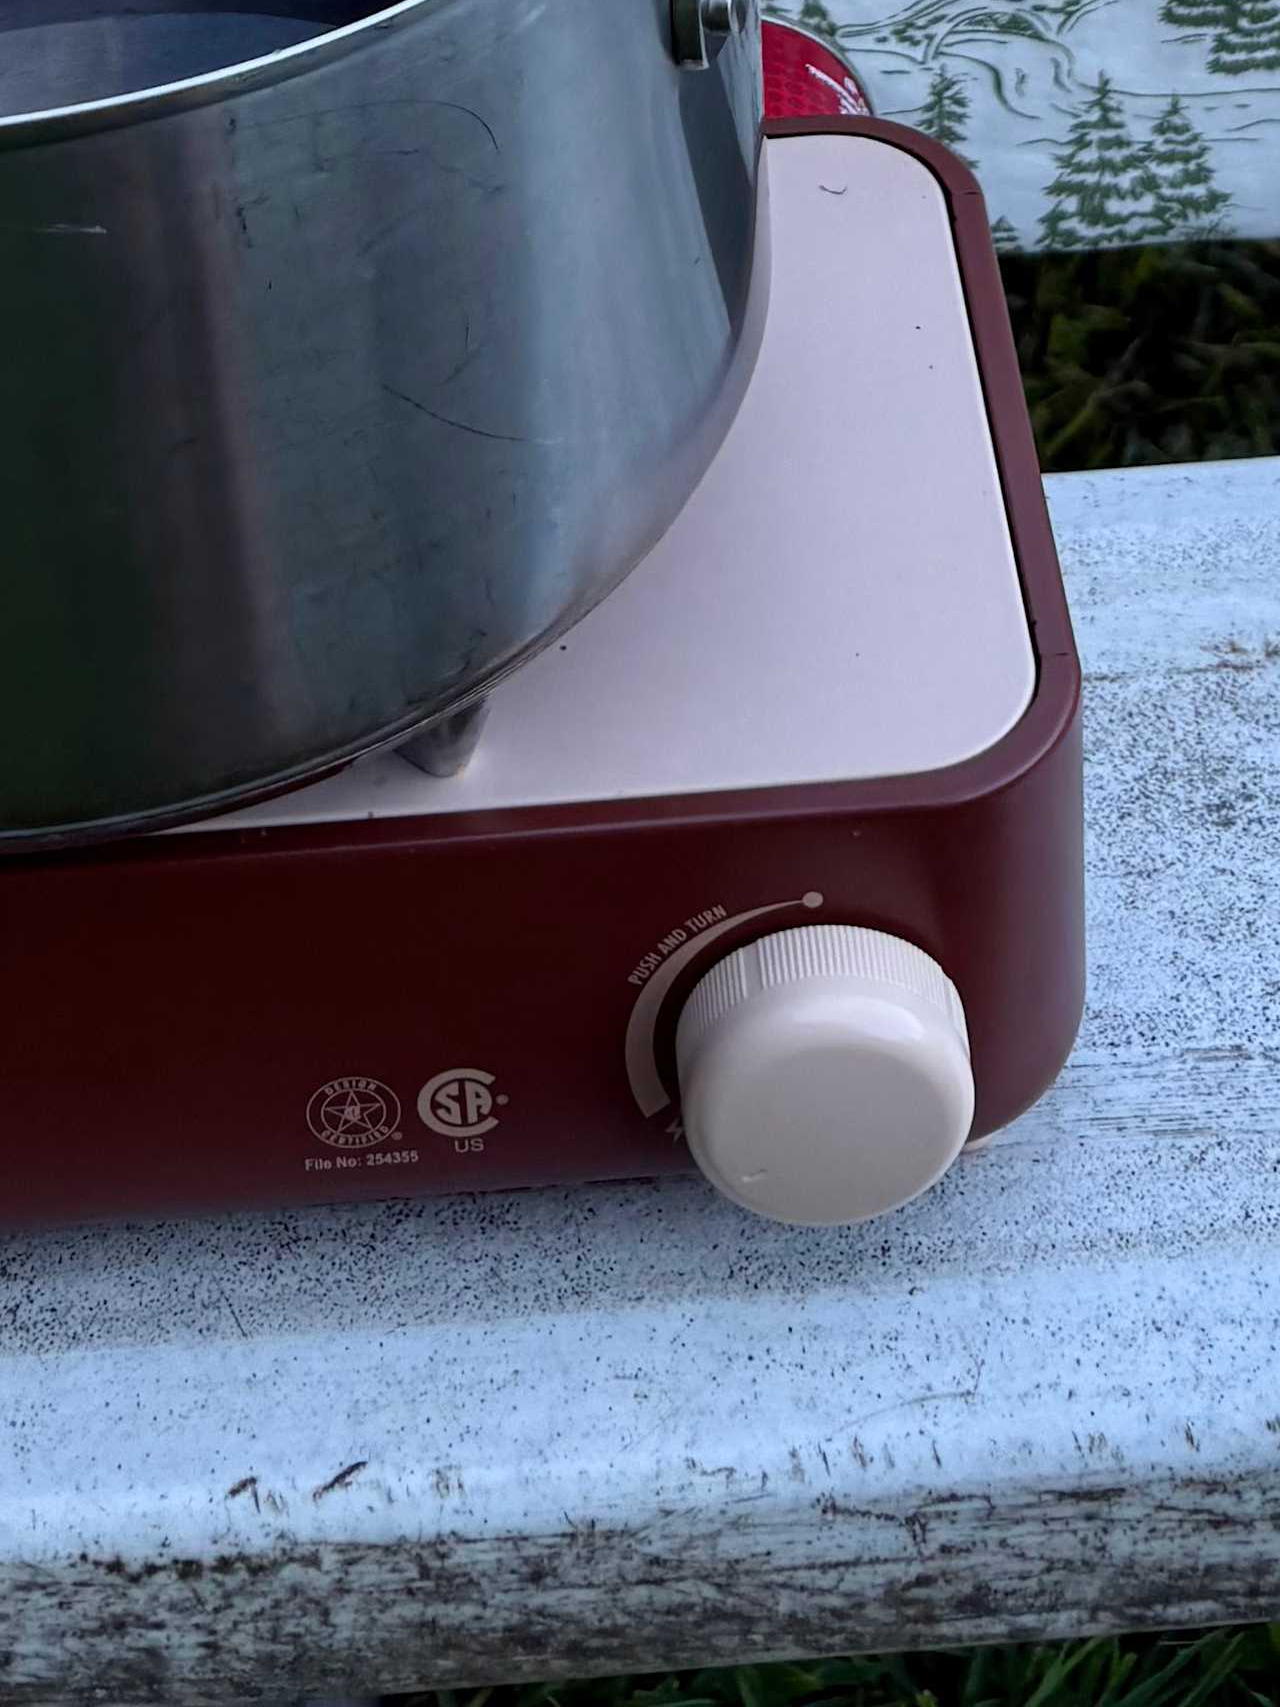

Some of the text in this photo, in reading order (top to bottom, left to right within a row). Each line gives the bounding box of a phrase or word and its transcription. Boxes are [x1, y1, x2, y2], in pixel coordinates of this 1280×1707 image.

[627, 904, 729, 986] PUSH AND TURN
[324, 1078, 377, 1095] DESIGN
[320, 1125, 389, 1146] CERTIFIED
[455, 1139, 485, 1154] US
[336, 1155, 363, 1169] No:
